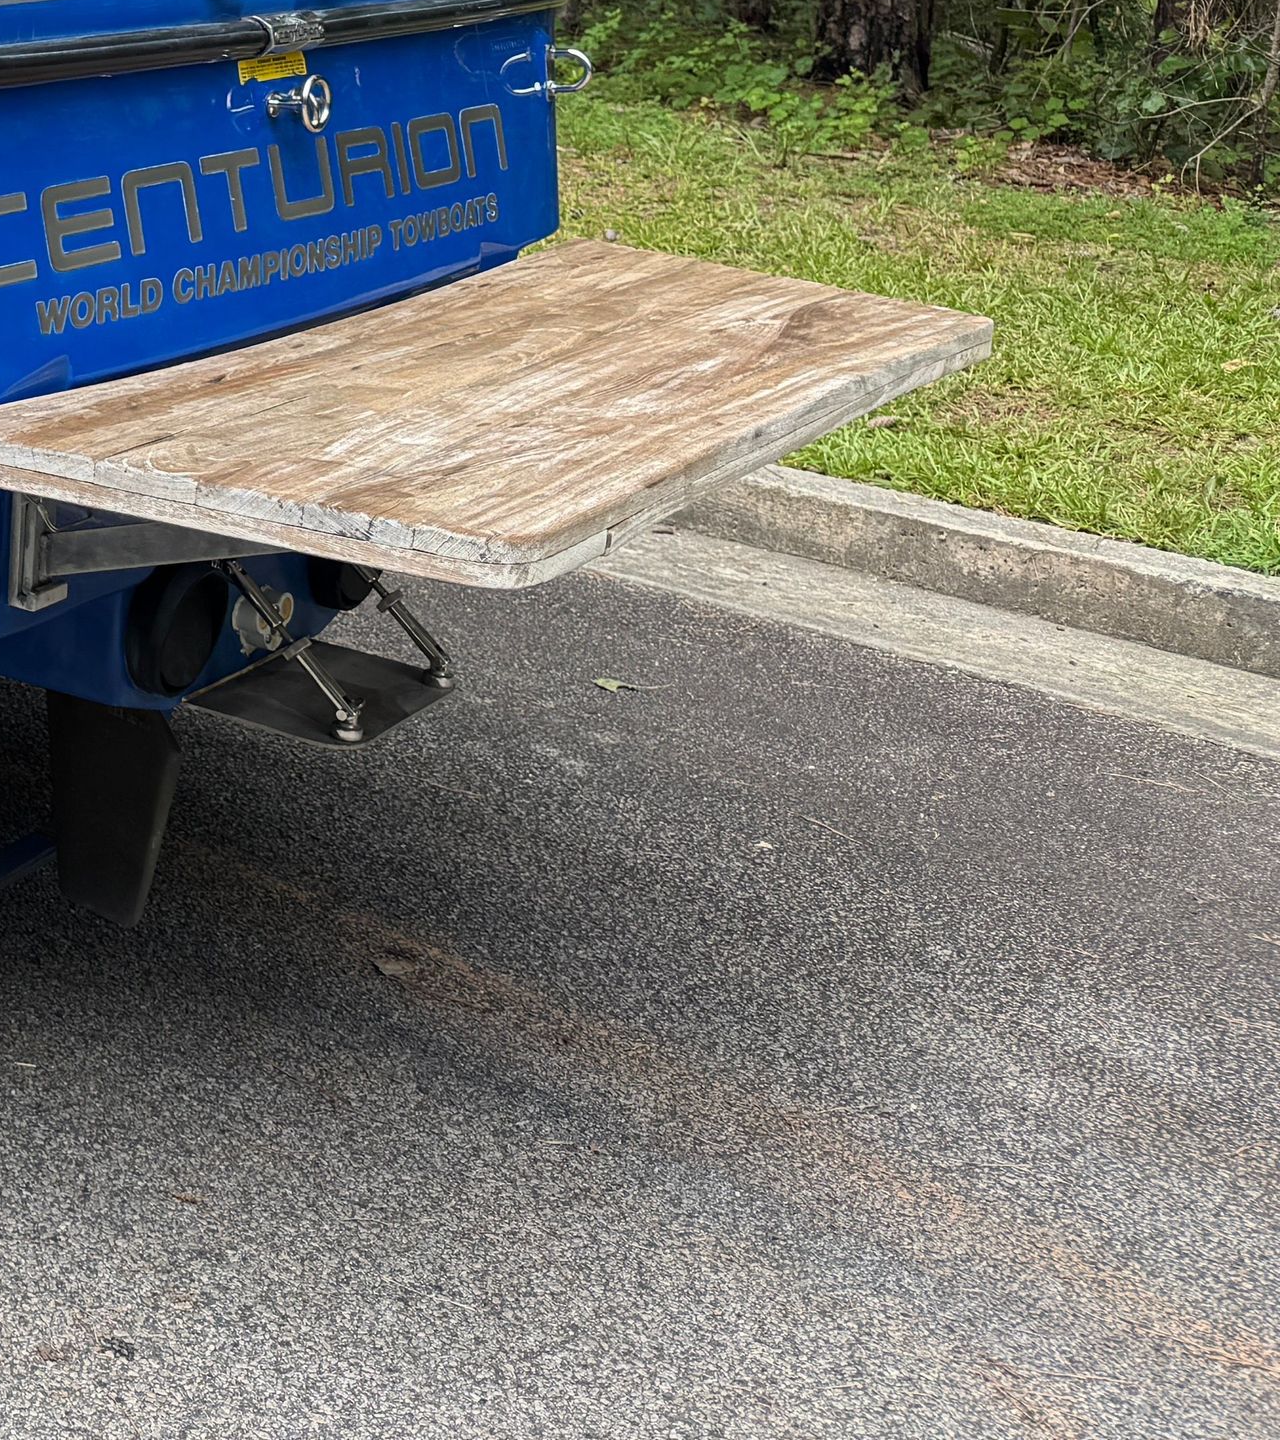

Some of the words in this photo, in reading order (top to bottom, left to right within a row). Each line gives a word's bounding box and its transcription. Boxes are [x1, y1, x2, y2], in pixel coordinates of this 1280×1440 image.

[35, 277, 163, 335] WORLD
[172, 224, 383, 304] CHAMPIONSHIP
[389, 192, 500, 250] TOWBOATS
